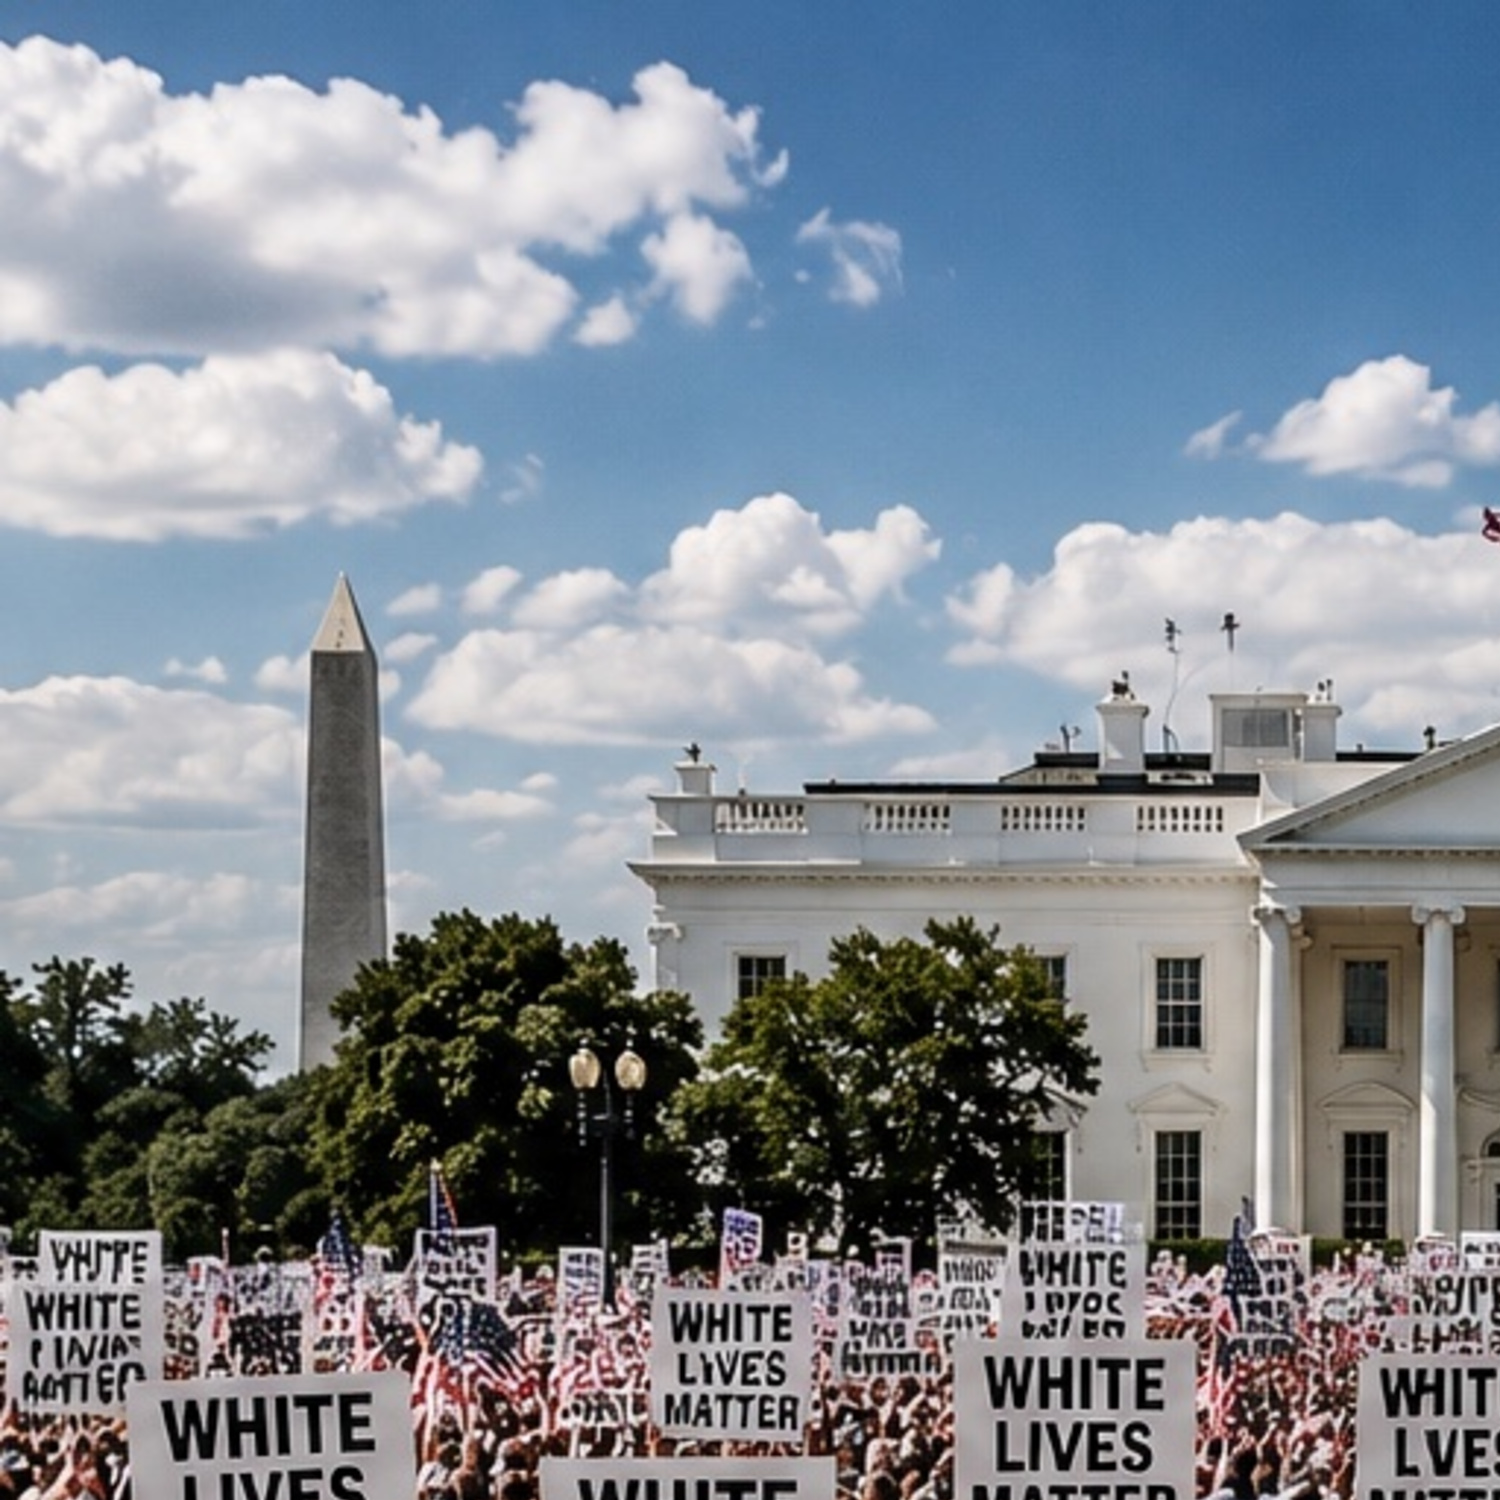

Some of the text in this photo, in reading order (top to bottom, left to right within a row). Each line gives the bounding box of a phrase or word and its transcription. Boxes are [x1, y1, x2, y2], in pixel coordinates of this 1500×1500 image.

[25, 1292, 140, 1331] WHITE
[669, 1302, 791, 1343] WHITE
[984, 1356, 1165, 1410] WHITE
[161, 1392, 375, 1462] WHITE
[664, 1393, 799, 1431] MATTER
[997, 1421, 1152, 1472] LIVES
